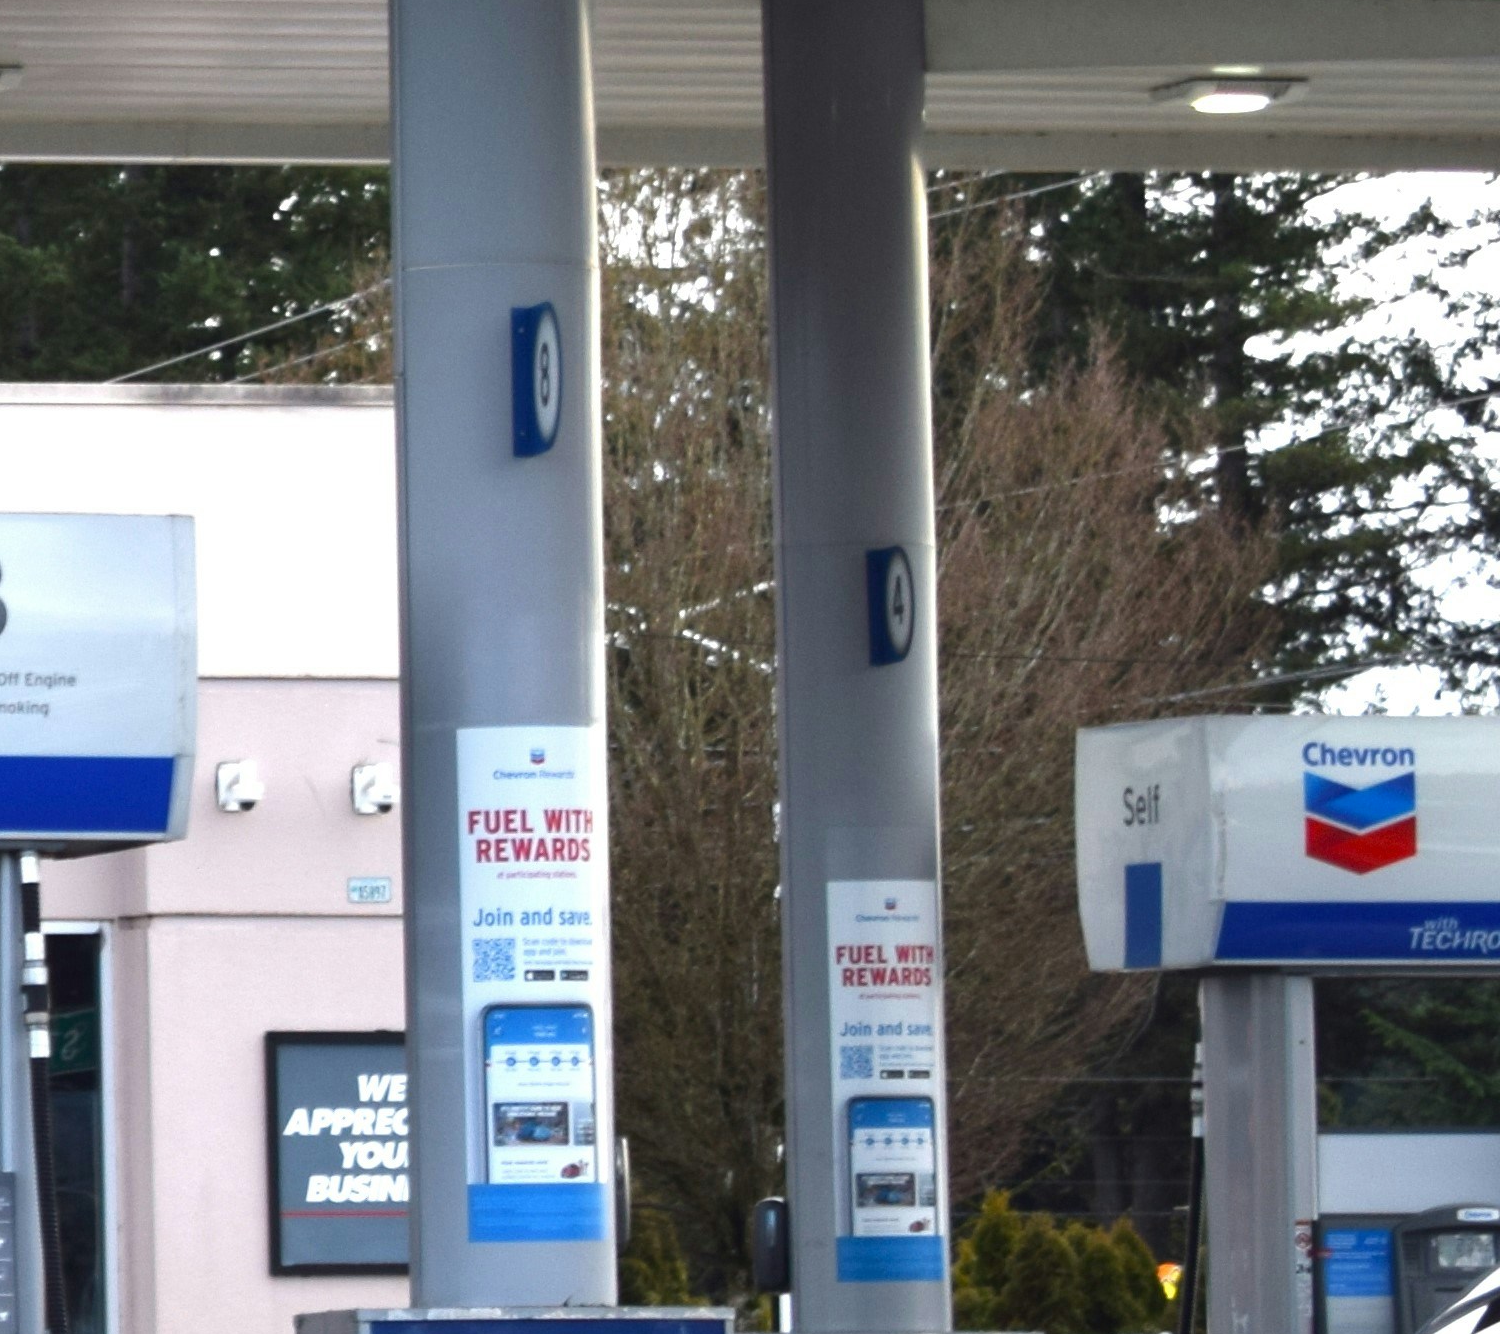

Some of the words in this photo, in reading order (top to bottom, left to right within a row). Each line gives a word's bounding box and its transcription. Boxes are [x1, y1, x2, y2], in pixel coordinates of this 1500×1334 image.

[539, 343, 550, 407] 8
[891, 574, 904, 623] 4
[24, 673, 77, 690] Engine
[1302, 742, 1415, 767] Chevron
[1122, 784, 1160, 826] Self
[468, 809, 534, 835] FUEL
[543, 809, 593, 834] WITH
[476, 837, 590, 863] REWARDS
[473, 907, 513, 927] Join
[520, 907, 553, 926] and
[558, 910, 592, 926] save.
[1423, 917, 1459, 931] with
[1409, 927, 1500, 953] TECHRO
[836, 945, 887, 965] FUEL
[894, 945, 934, 964] WITH
[842, 968, 932, 987] REWARDS
[840, 1022, 872, 1037] Join
[877, 1022, 902, 1036] and
[357, 1074, 408, 1102] WE
[283, 1108, 409, 1136] APPREC
[339, 1141, 409, 1169] YOU
